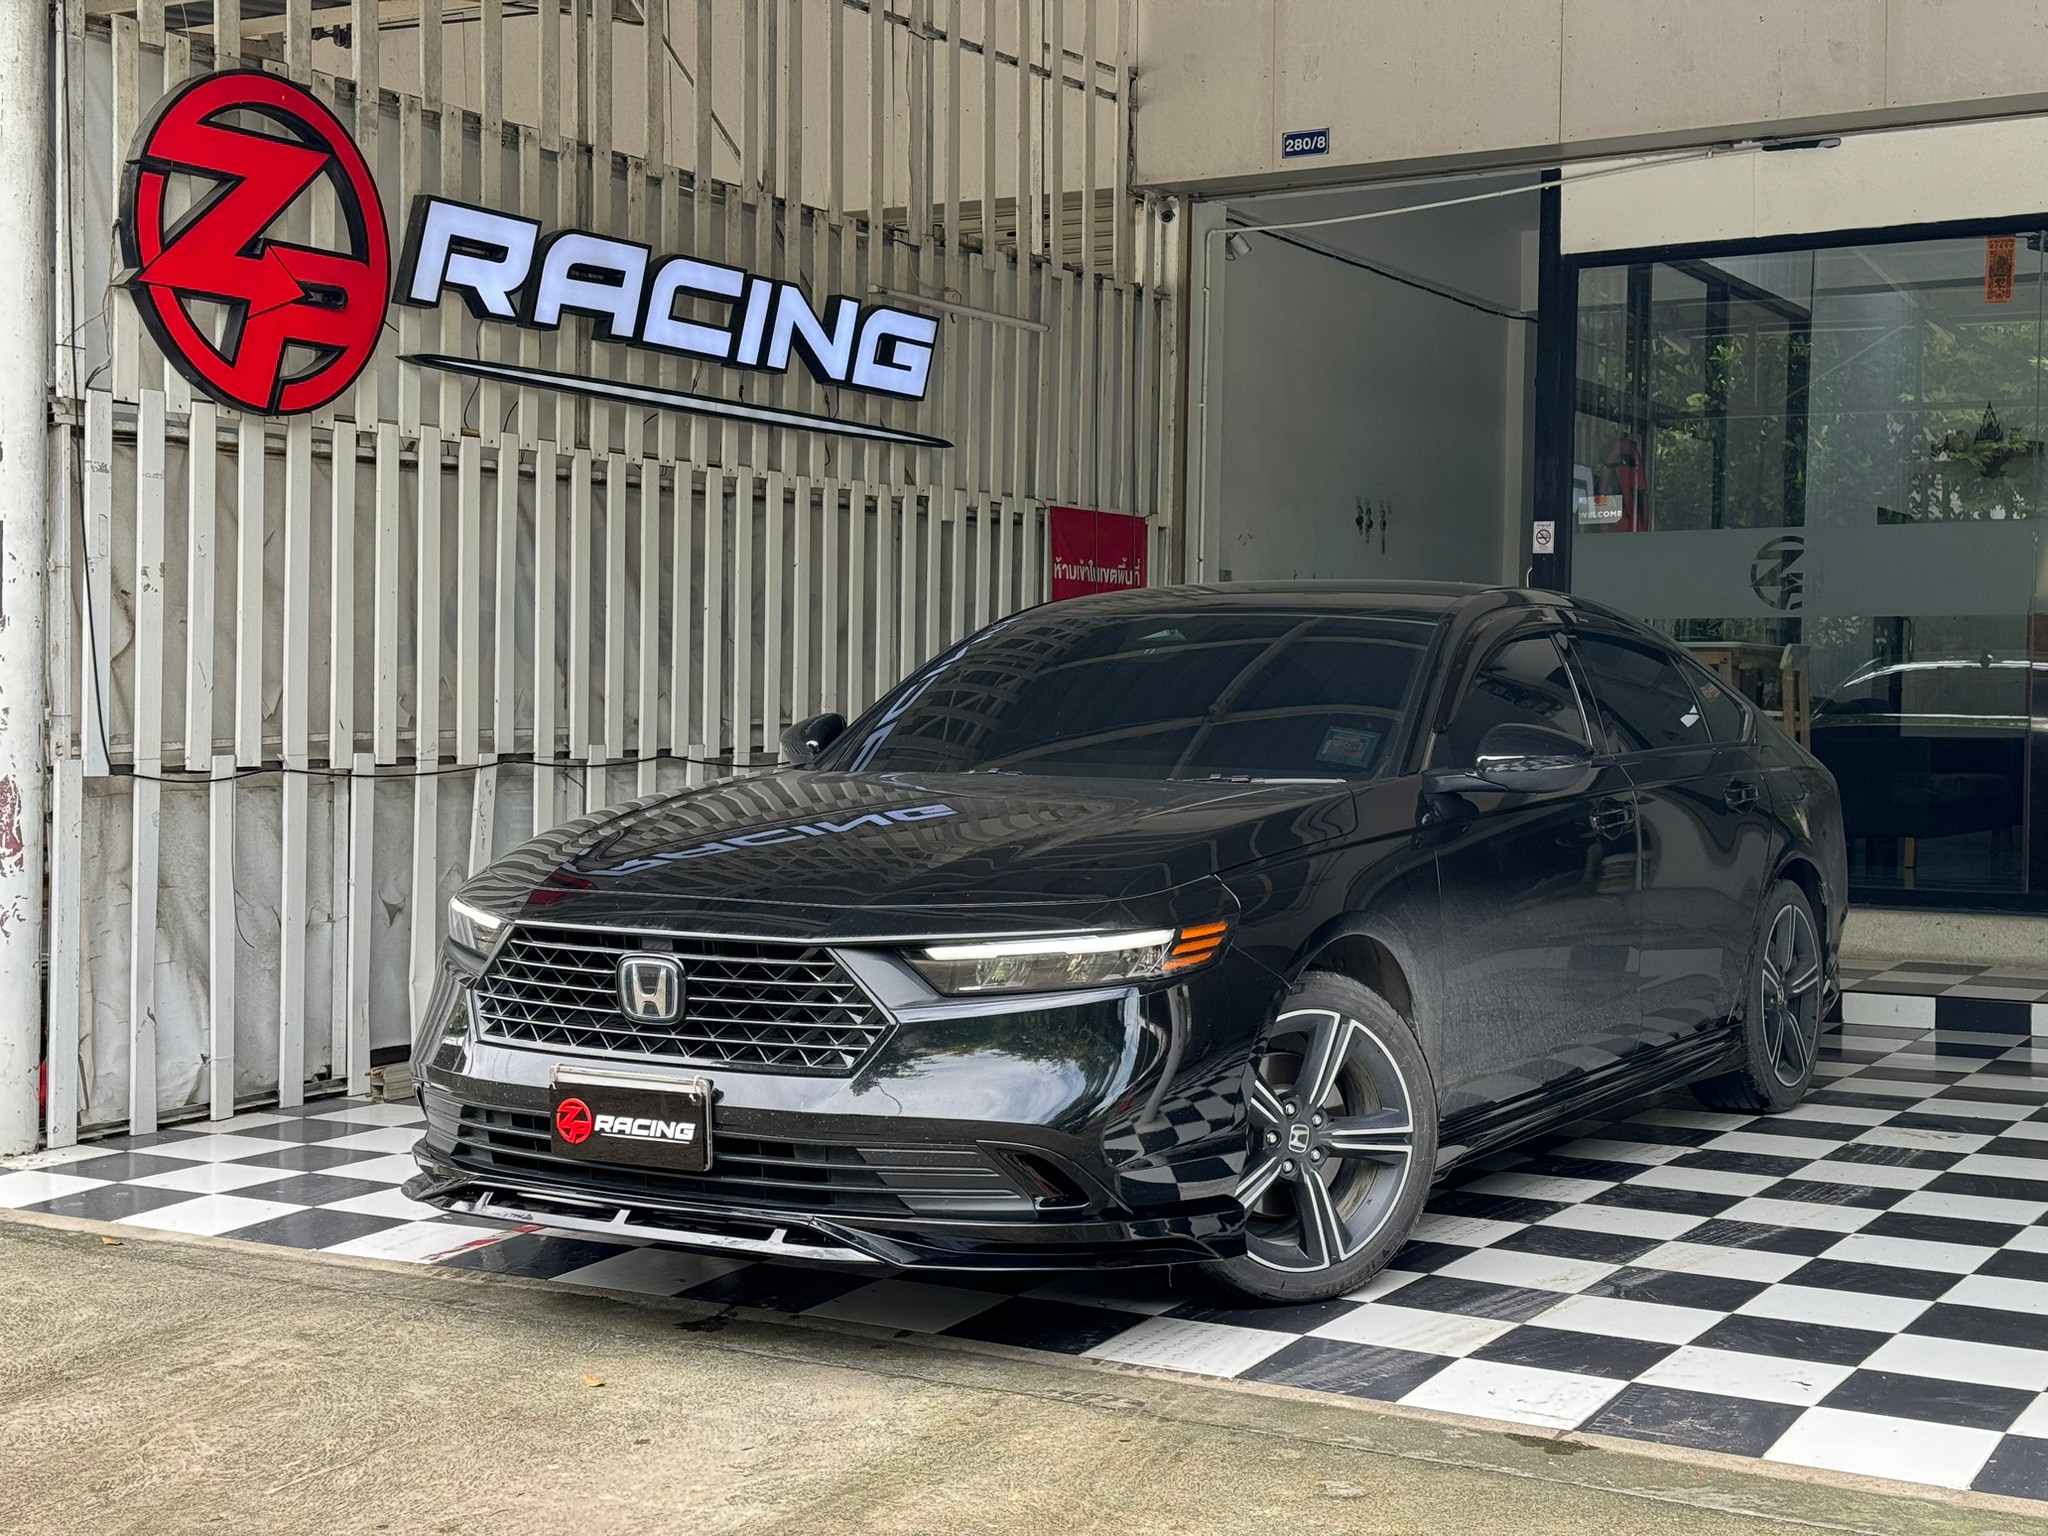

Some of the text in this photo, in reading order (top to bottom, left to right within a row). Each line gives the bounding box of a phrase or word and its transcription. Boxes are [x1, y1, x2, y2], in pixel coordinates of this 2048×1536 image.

[1285, 136, 1326, 152] 280/8
[408, 199, 938, 399] RACING
[593, 1114, 696, 1141] RACING
